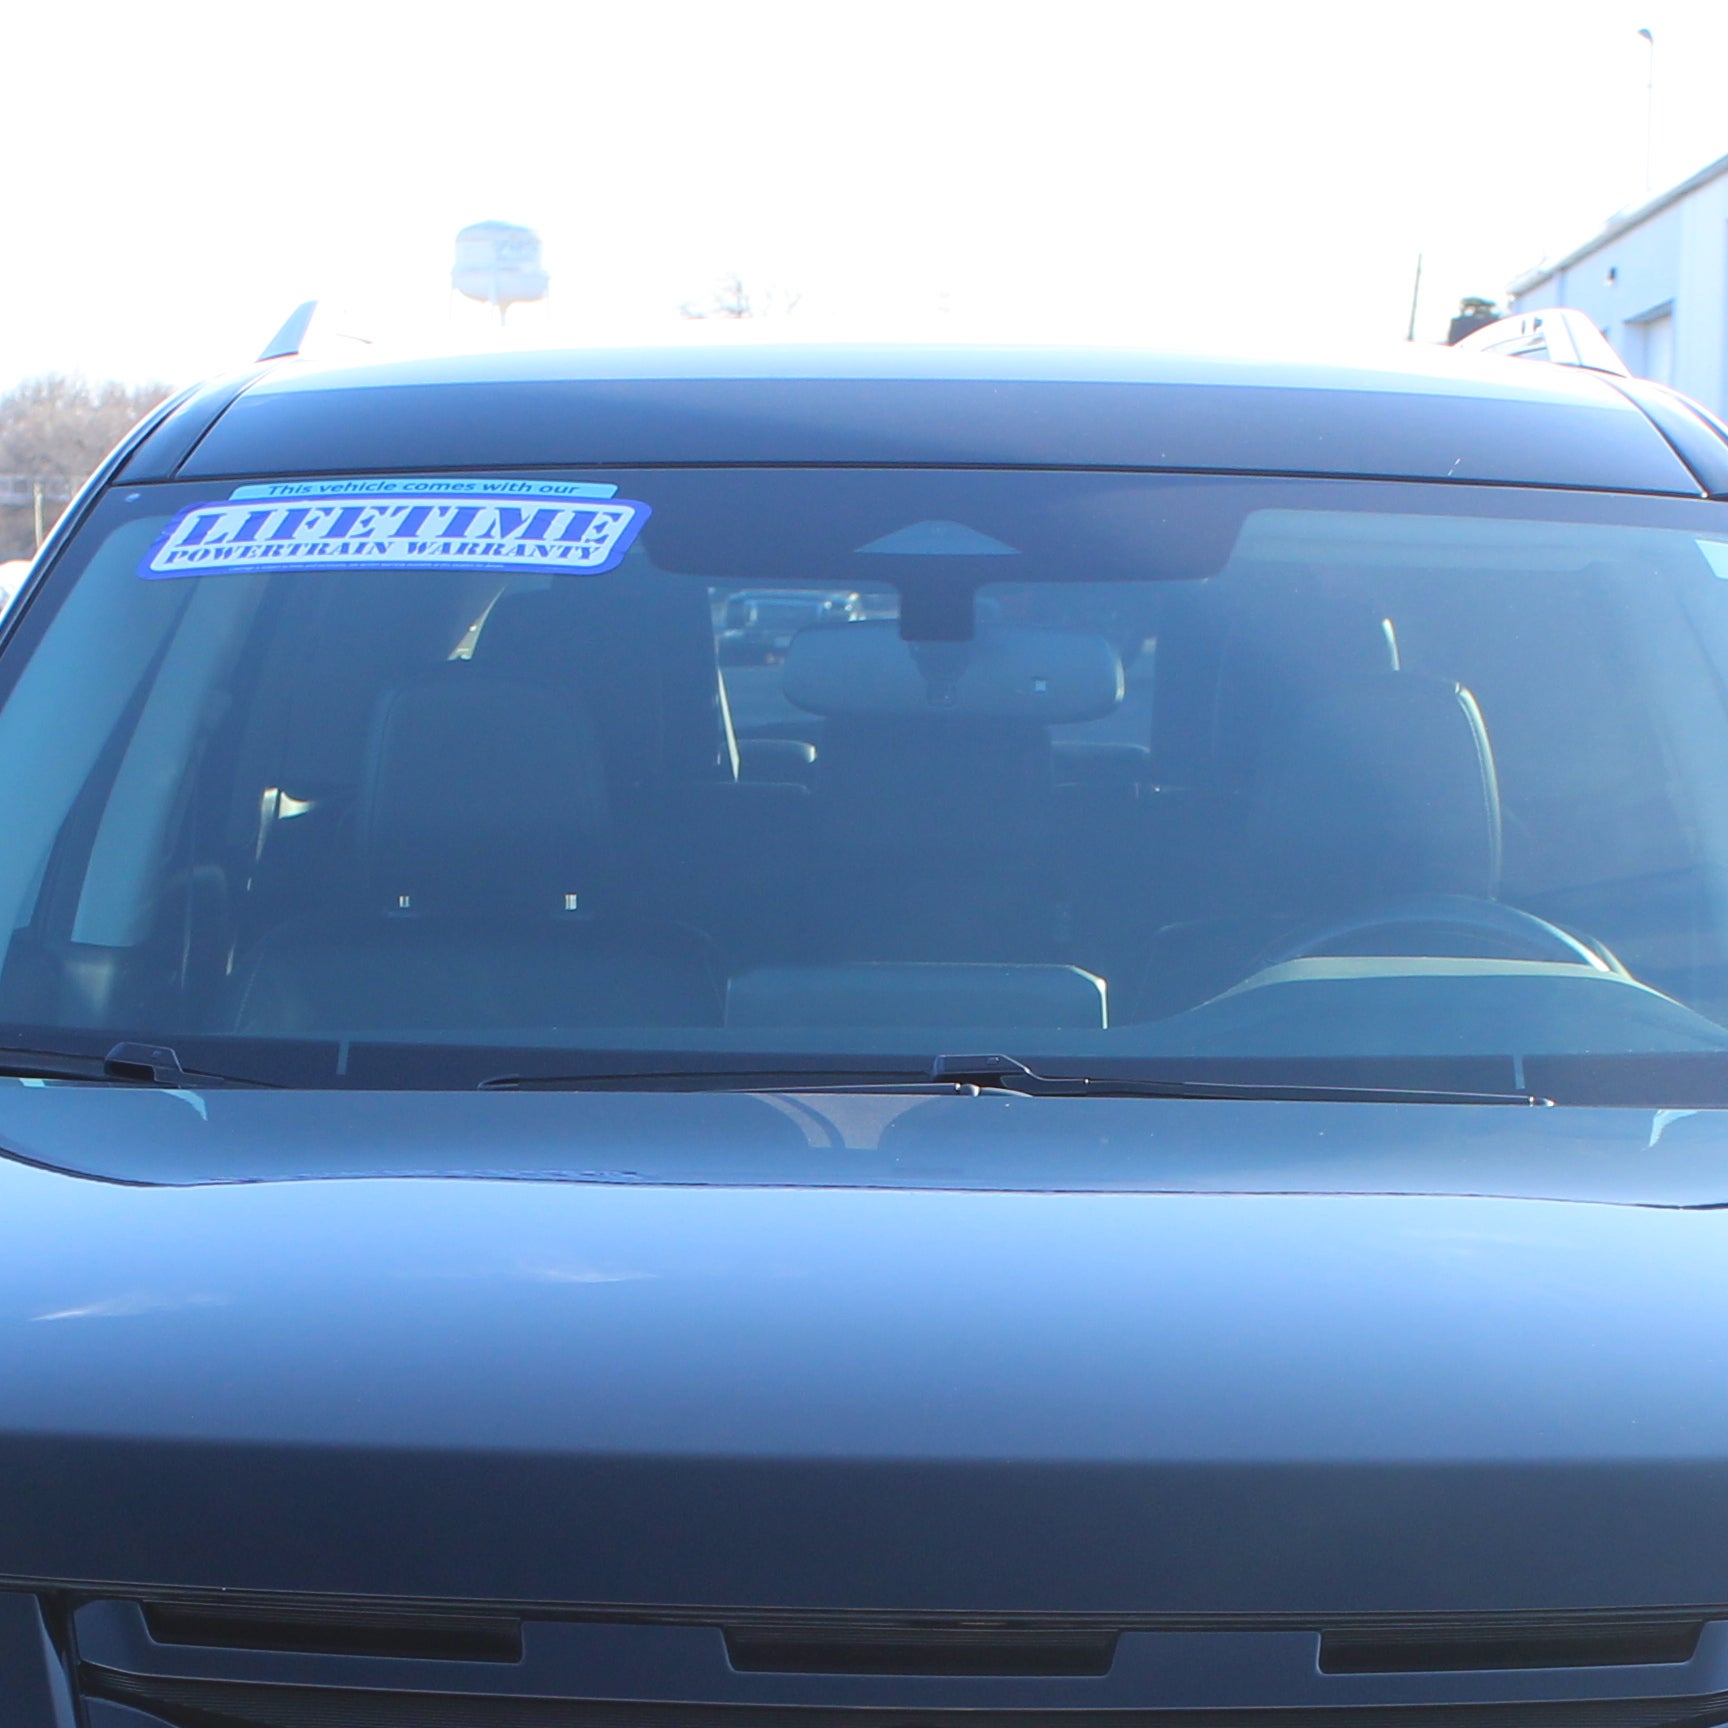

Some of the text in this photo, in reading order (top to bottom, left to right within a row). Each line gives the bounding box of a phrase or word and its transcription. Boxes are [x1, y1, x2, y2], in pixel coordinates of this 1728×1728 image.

[269, 480, 580, 496] This vehicle comes with our
[176, 505, 623, 546] LIFETIME
[164, 540, 600, 565] POWERTRAIN WARRANTY
